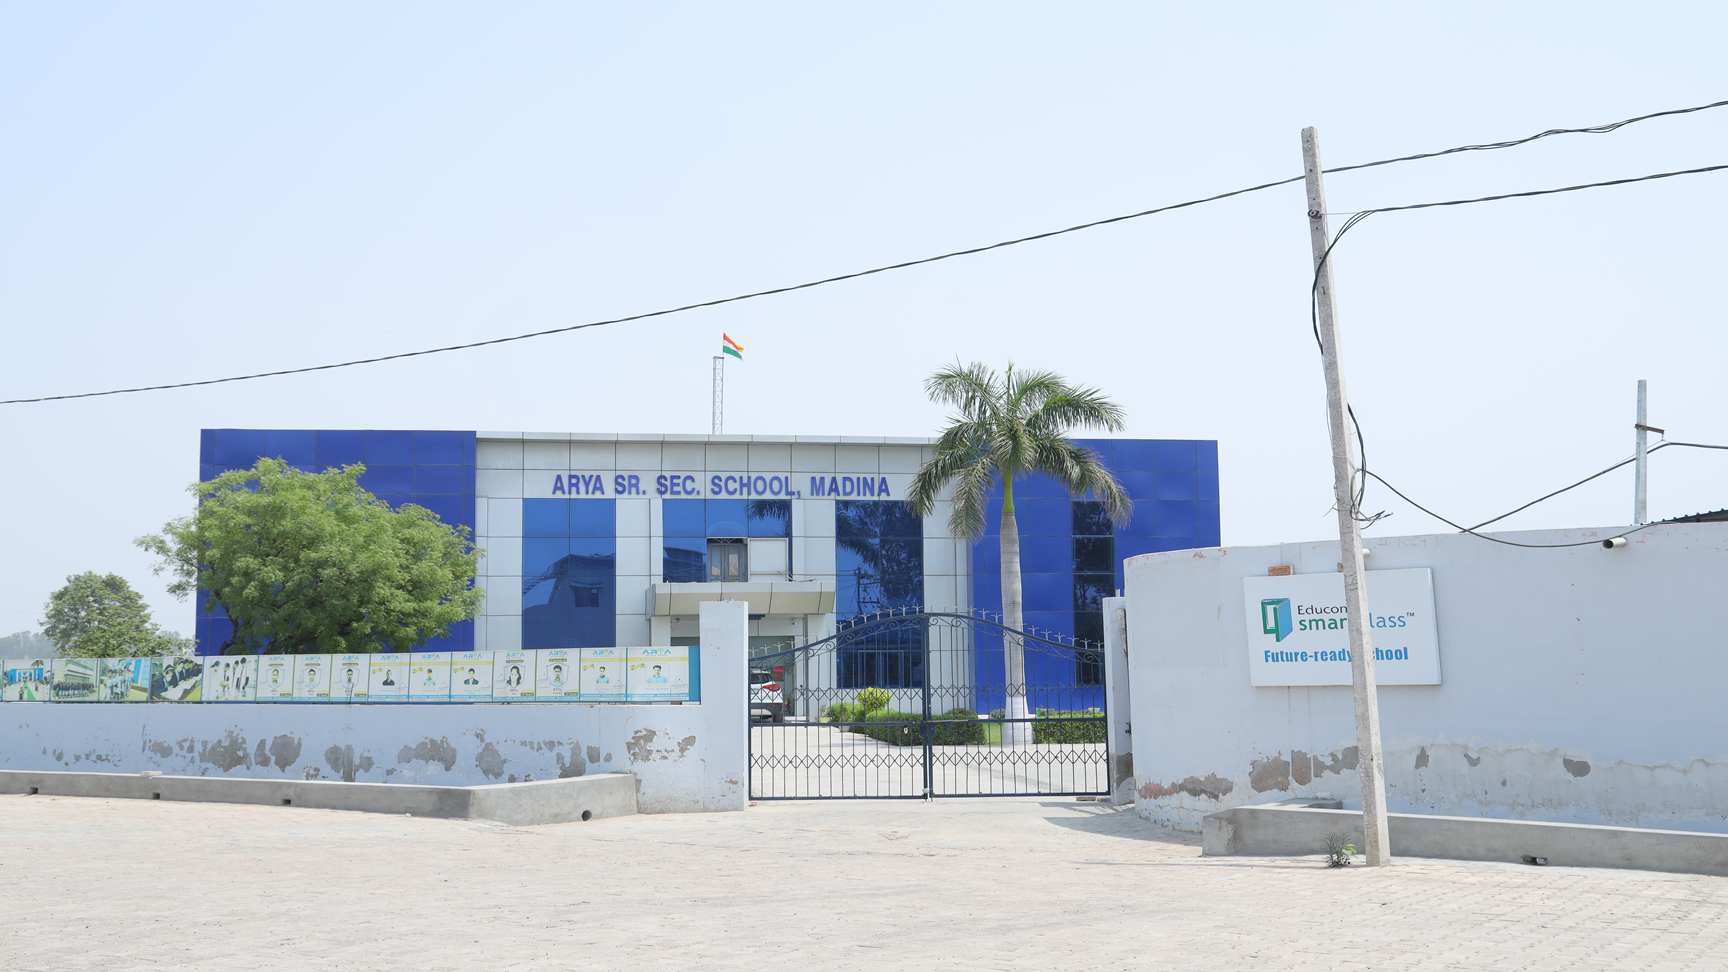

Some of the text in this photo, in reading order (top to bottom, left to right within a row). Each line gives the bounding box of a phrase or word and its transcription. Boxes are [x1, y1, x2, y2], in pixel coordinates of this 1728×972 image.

[552, 474, 891, 499] ARYA SR. SEC. SCHOOL, MADINA
[1297, 605, 1348, 615] Educom
[1371, 647, 1409, 661] hool
